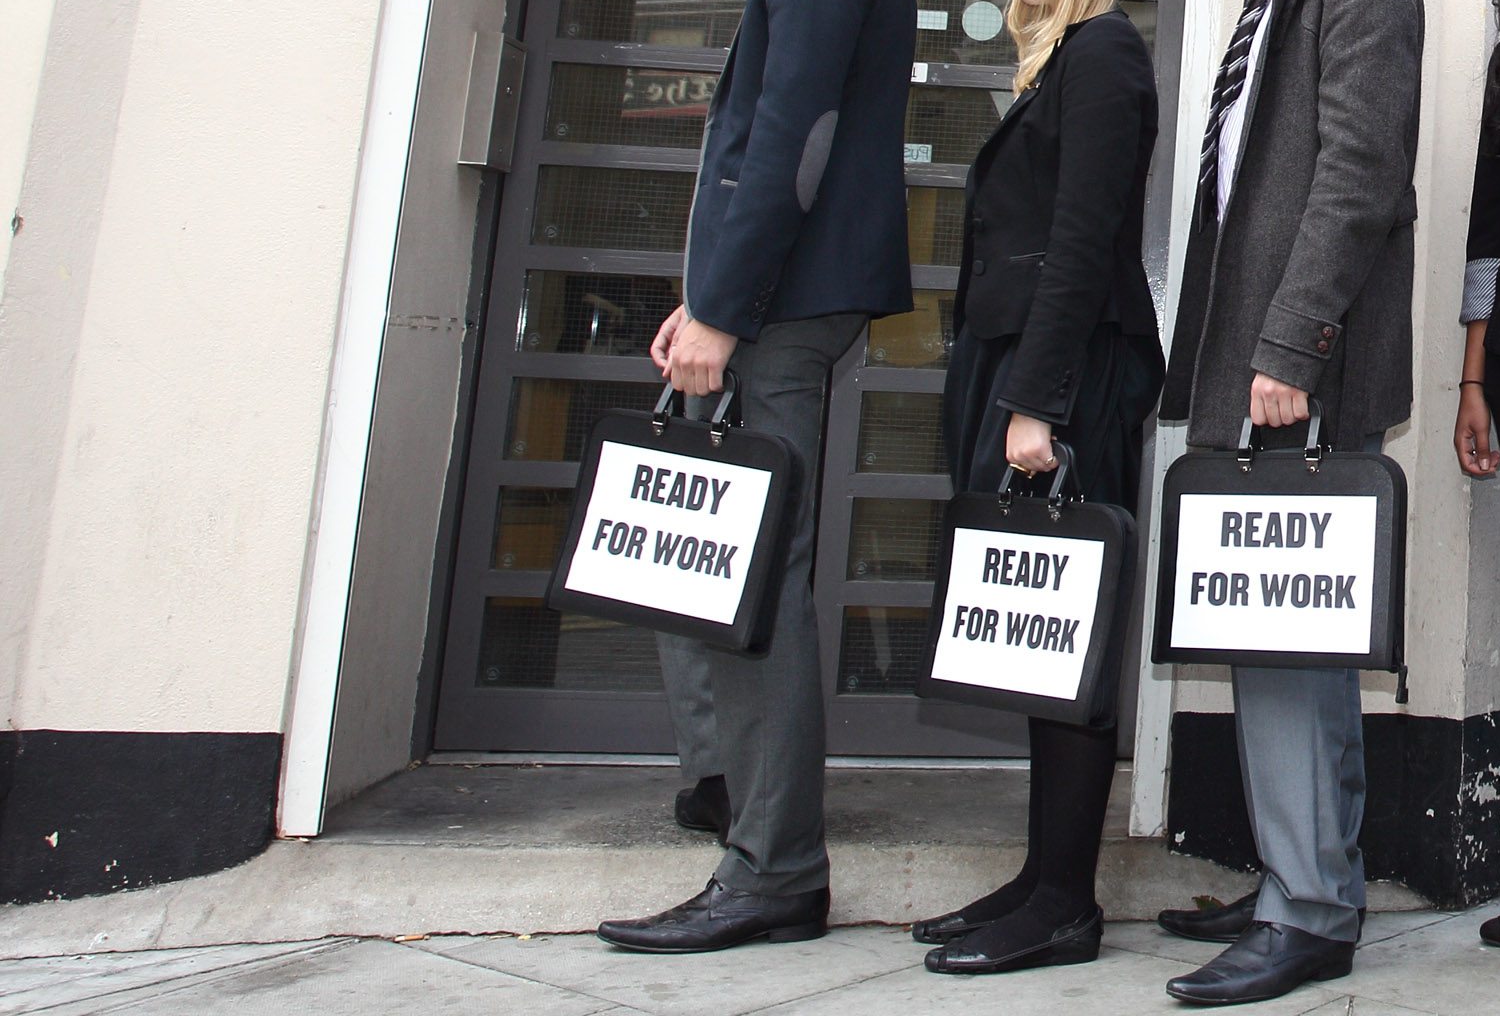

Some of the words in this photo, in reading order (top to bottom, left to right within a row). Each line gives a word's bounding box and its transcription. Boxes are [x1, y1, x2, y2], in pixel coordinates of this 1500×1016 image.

[630, 464, 731, 515] READY
[592, 518, 648, 560] FOR
[653, 530, 738, 579] WORK
[1220, 511, 1332, 548] READY
[982, 547, 1069, 591] READY
[1190, 572, 1249, 606] FOR
[1260, 573, 1356, 609] WORK
[952, 605, 999, 643] FOR
[1006, 611, 1080, 654] WORK
